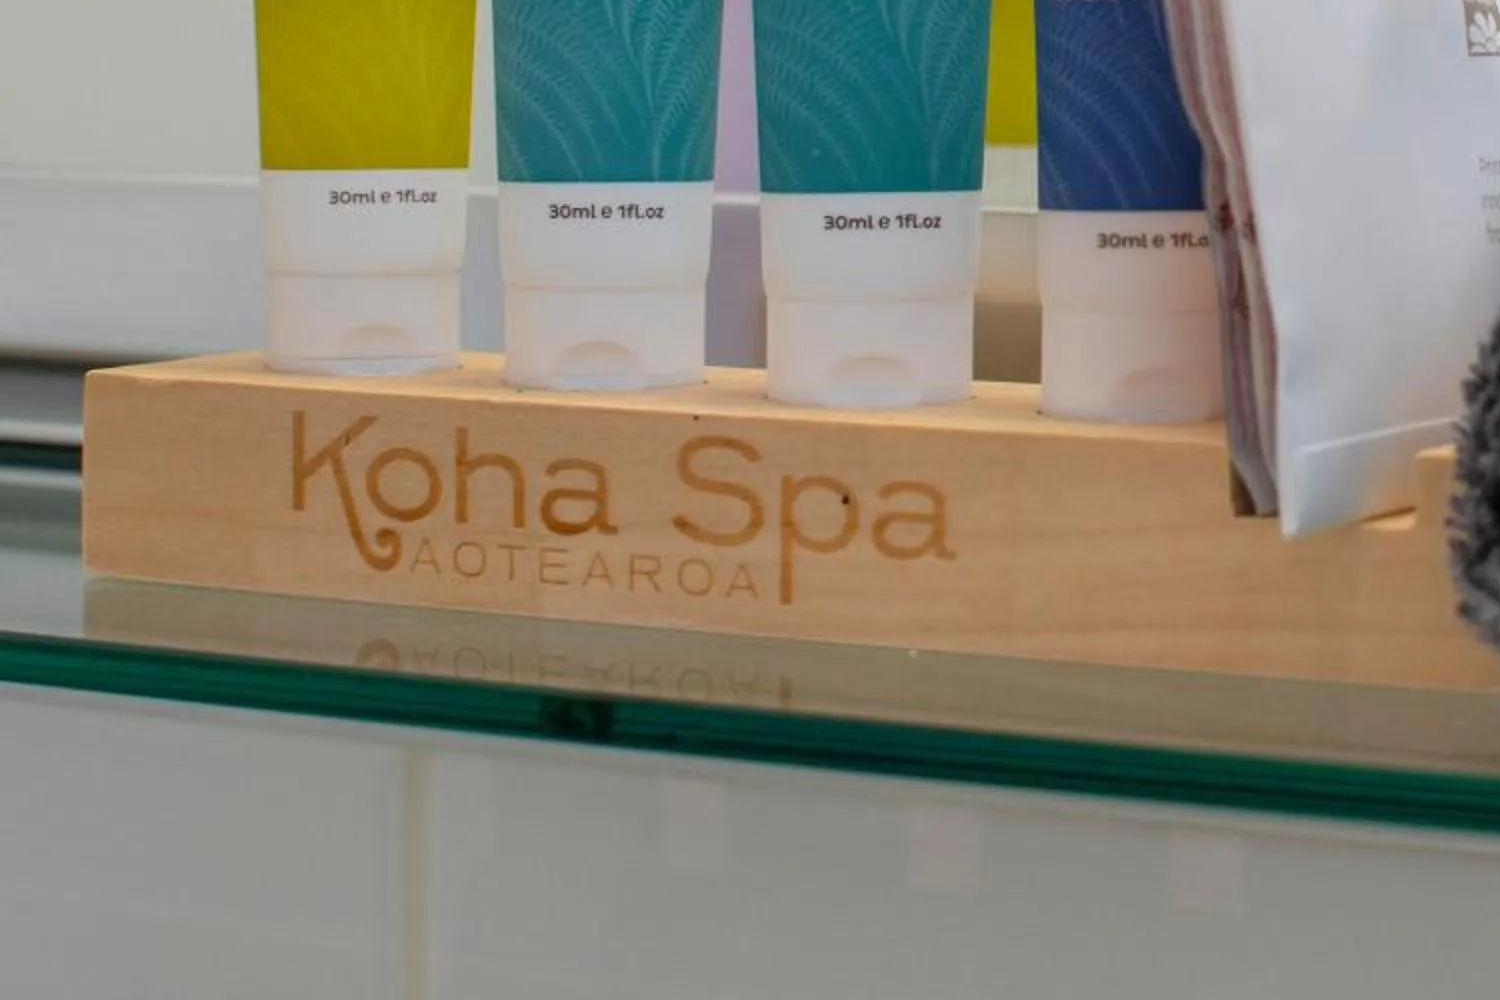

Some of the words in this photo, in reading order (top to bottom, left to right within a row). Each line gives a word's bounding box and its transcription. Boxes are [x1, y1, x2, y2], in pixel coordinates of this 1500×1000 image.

[328, 189, 376, 205] 30ml
[549, 203, 597, 219] 30ml
[823, 214, 873, 231] 30ml
[1096, 232, 1148, 249] 30ml
[1169, 232, 1210, 248] 1fl.o
[291, 410, 619, 571] Koha
[671, 436, 958, 605] Spa
[409, 538, 759, 602] AOTEAROA
